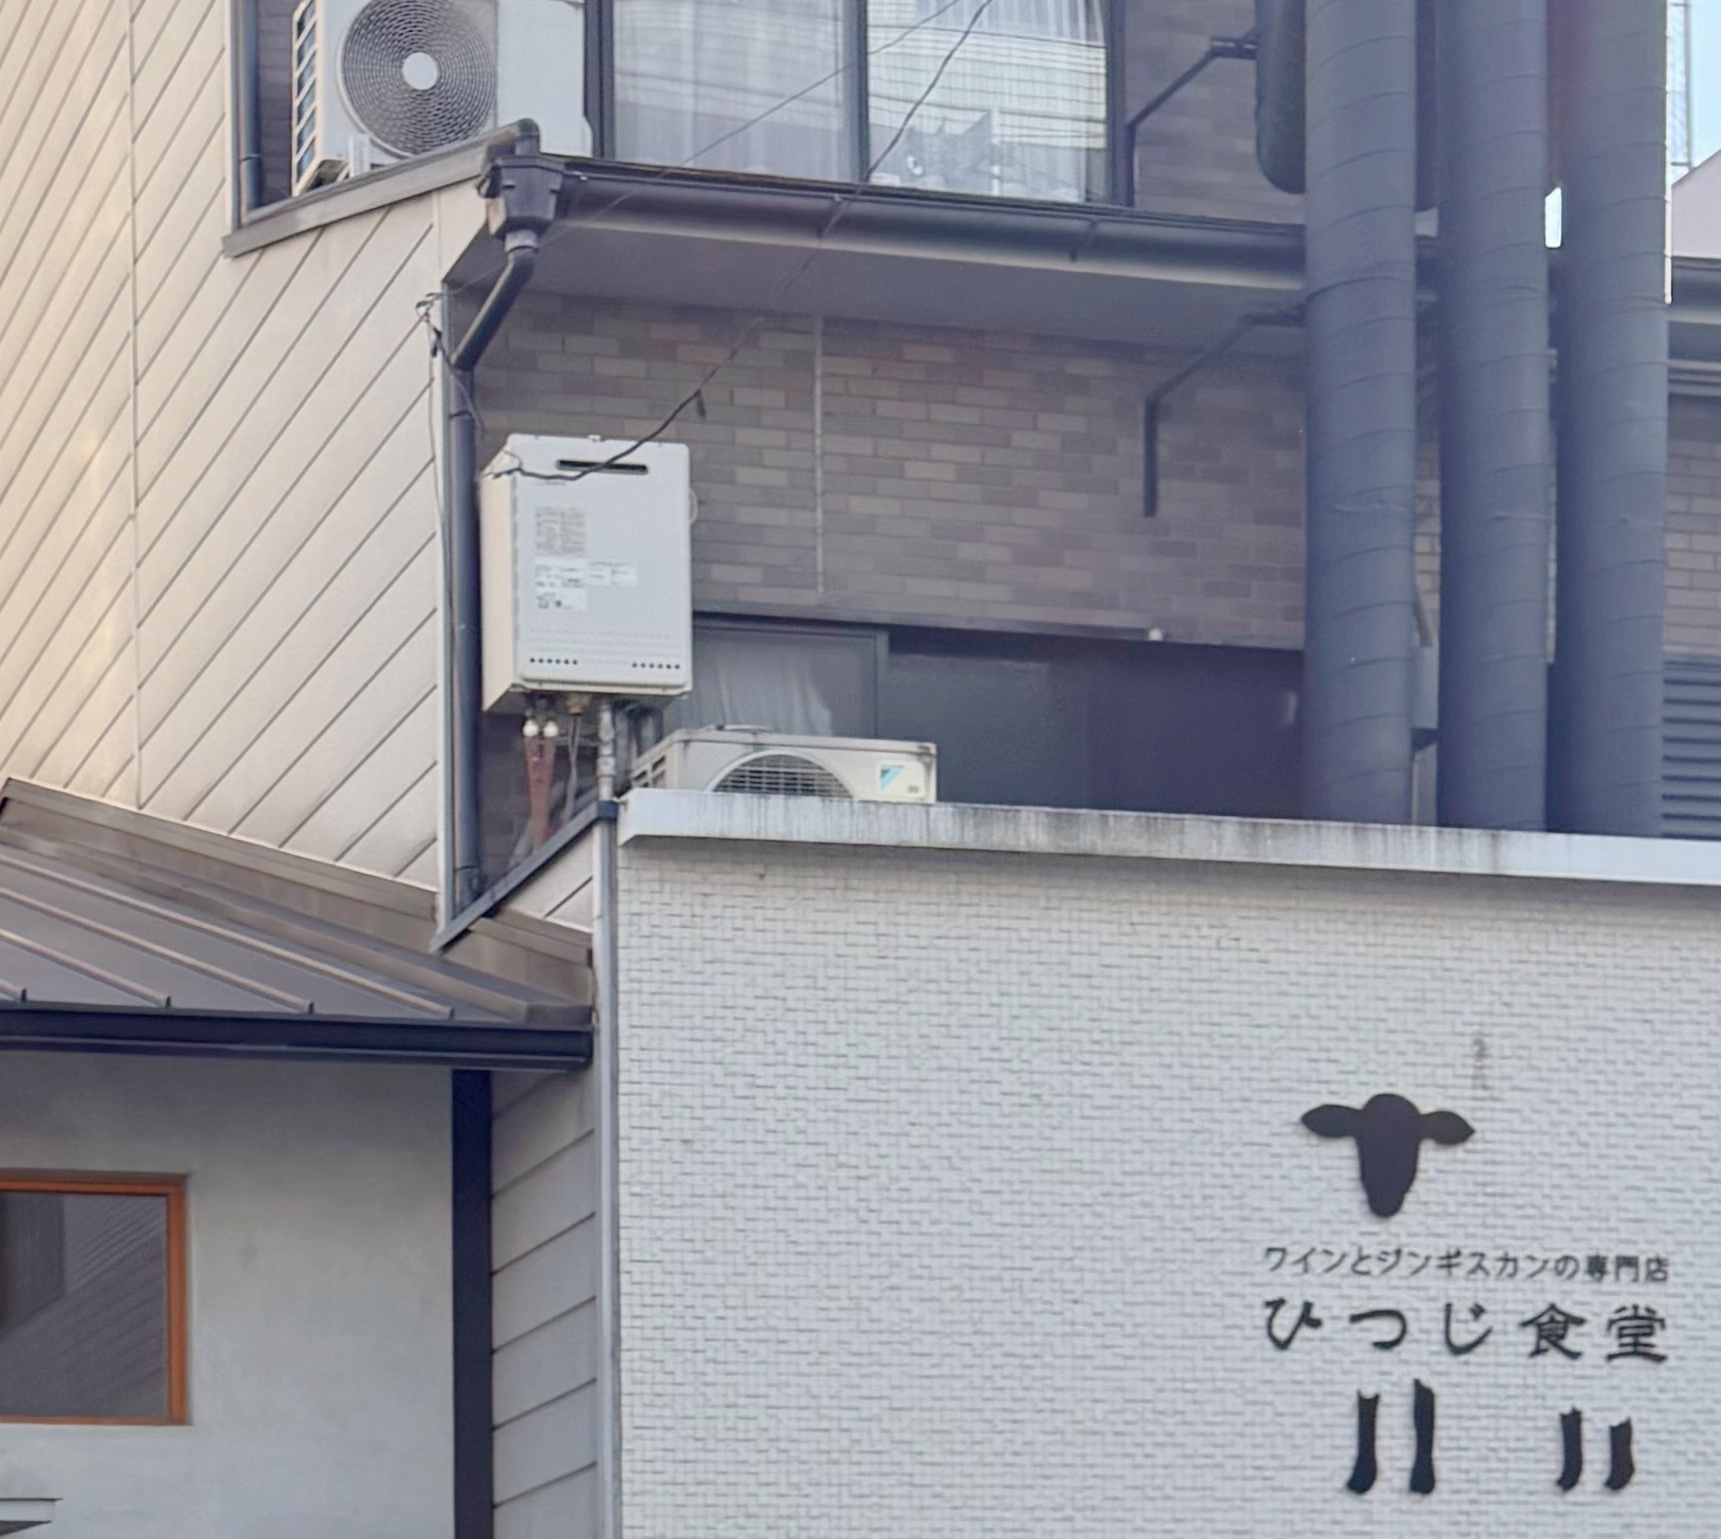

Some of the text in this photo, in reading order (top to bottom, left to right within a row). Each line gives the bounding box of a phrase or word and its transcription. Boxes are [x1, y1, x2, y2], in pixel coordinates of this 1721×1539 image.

[1265, 1247, 1669, 1282] ワインとジンギスカンの専門店
[1264, 1298, 1668, 1363] ひつじ食堂
